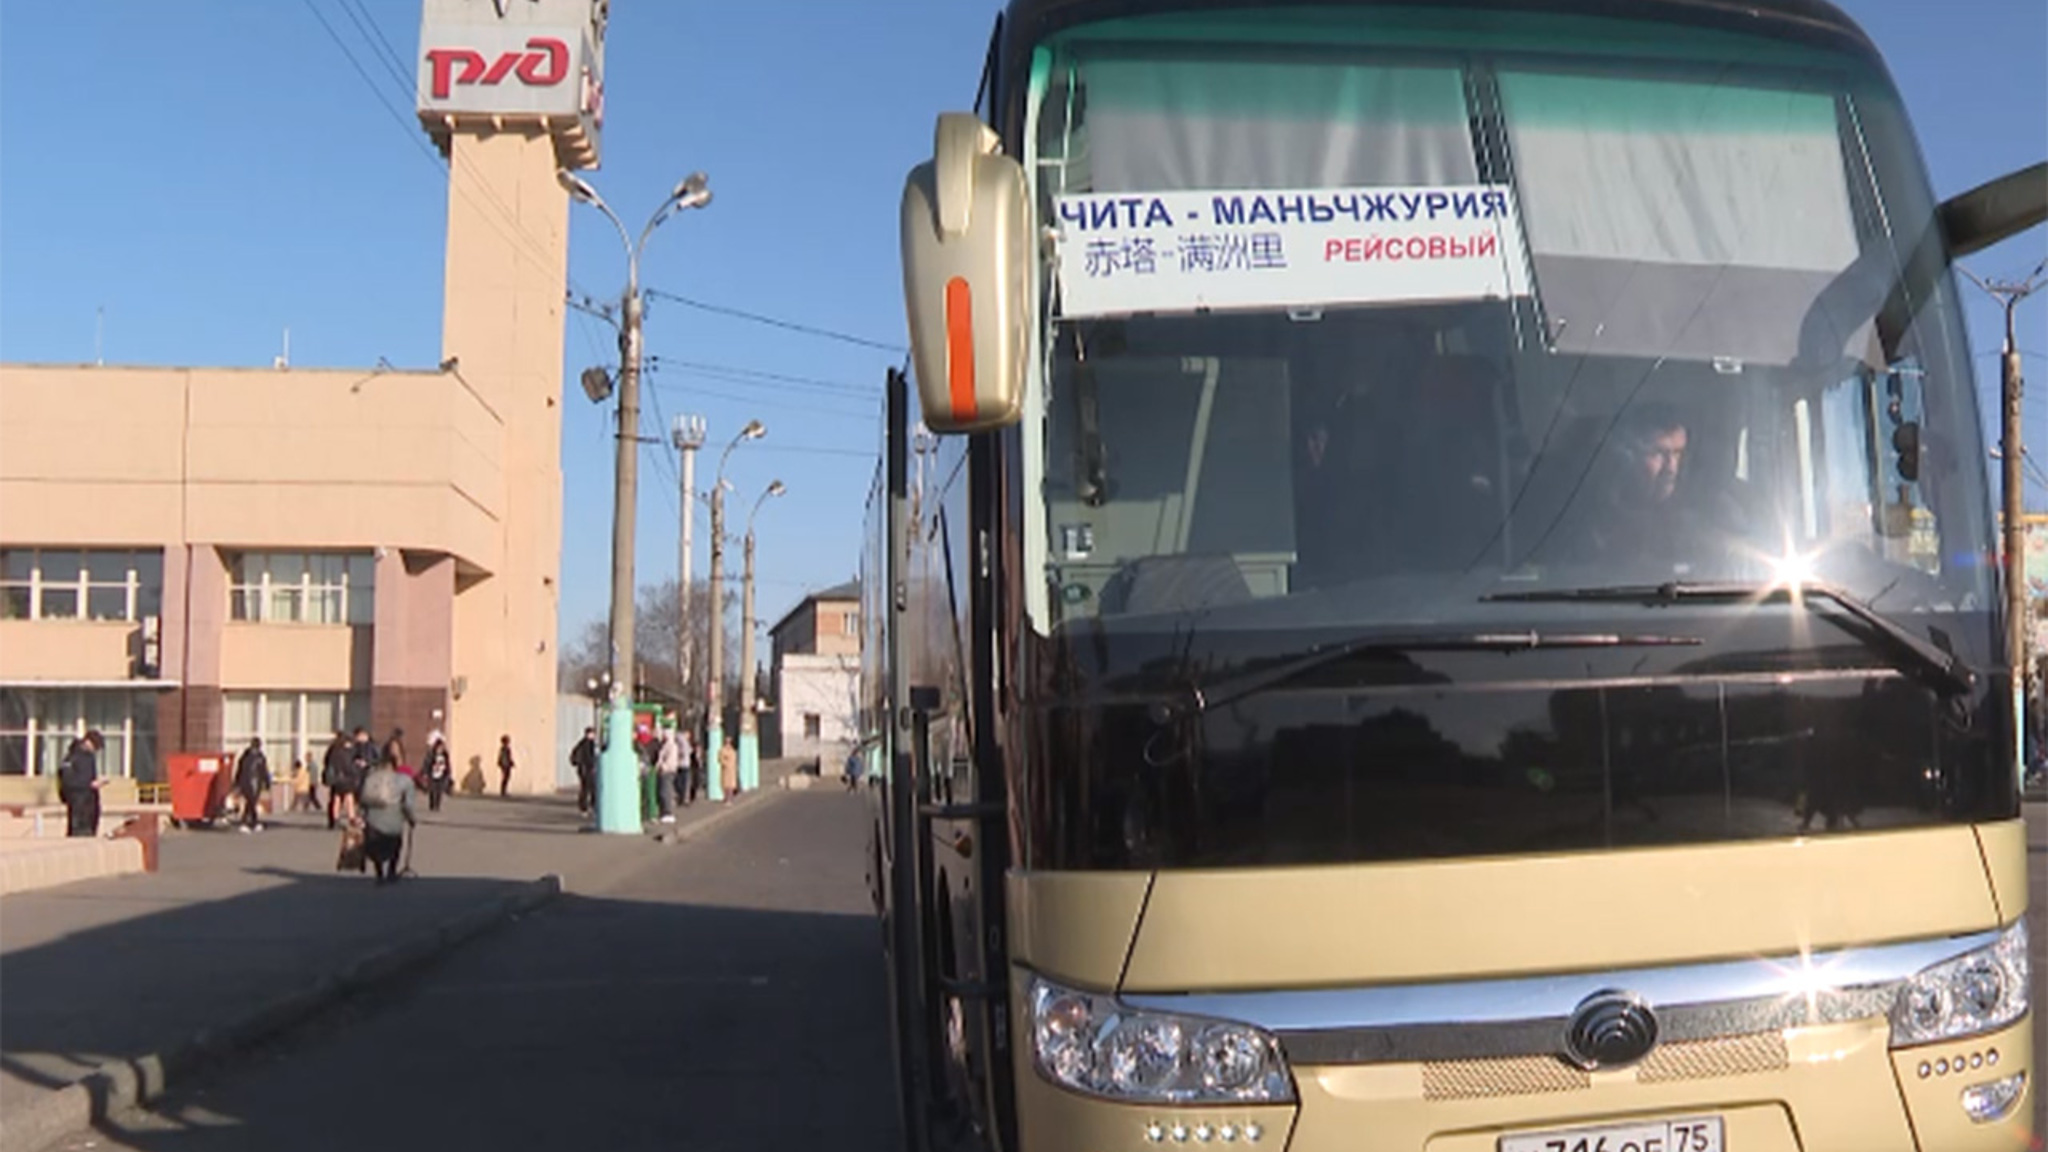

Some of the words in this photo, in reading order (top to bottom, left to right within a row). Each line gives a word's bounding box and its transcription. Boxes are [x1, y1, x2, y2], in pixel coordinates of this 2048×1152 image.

[1060, 198, 1173, 231] ЧИТА
[1213, 192, 1509, 225] МАНЬЧЖУРИЯ
[1324, 231, 1497, 263] РЕЙСОВЫЙ
[1674, 1124, 1709, 1152] 75
